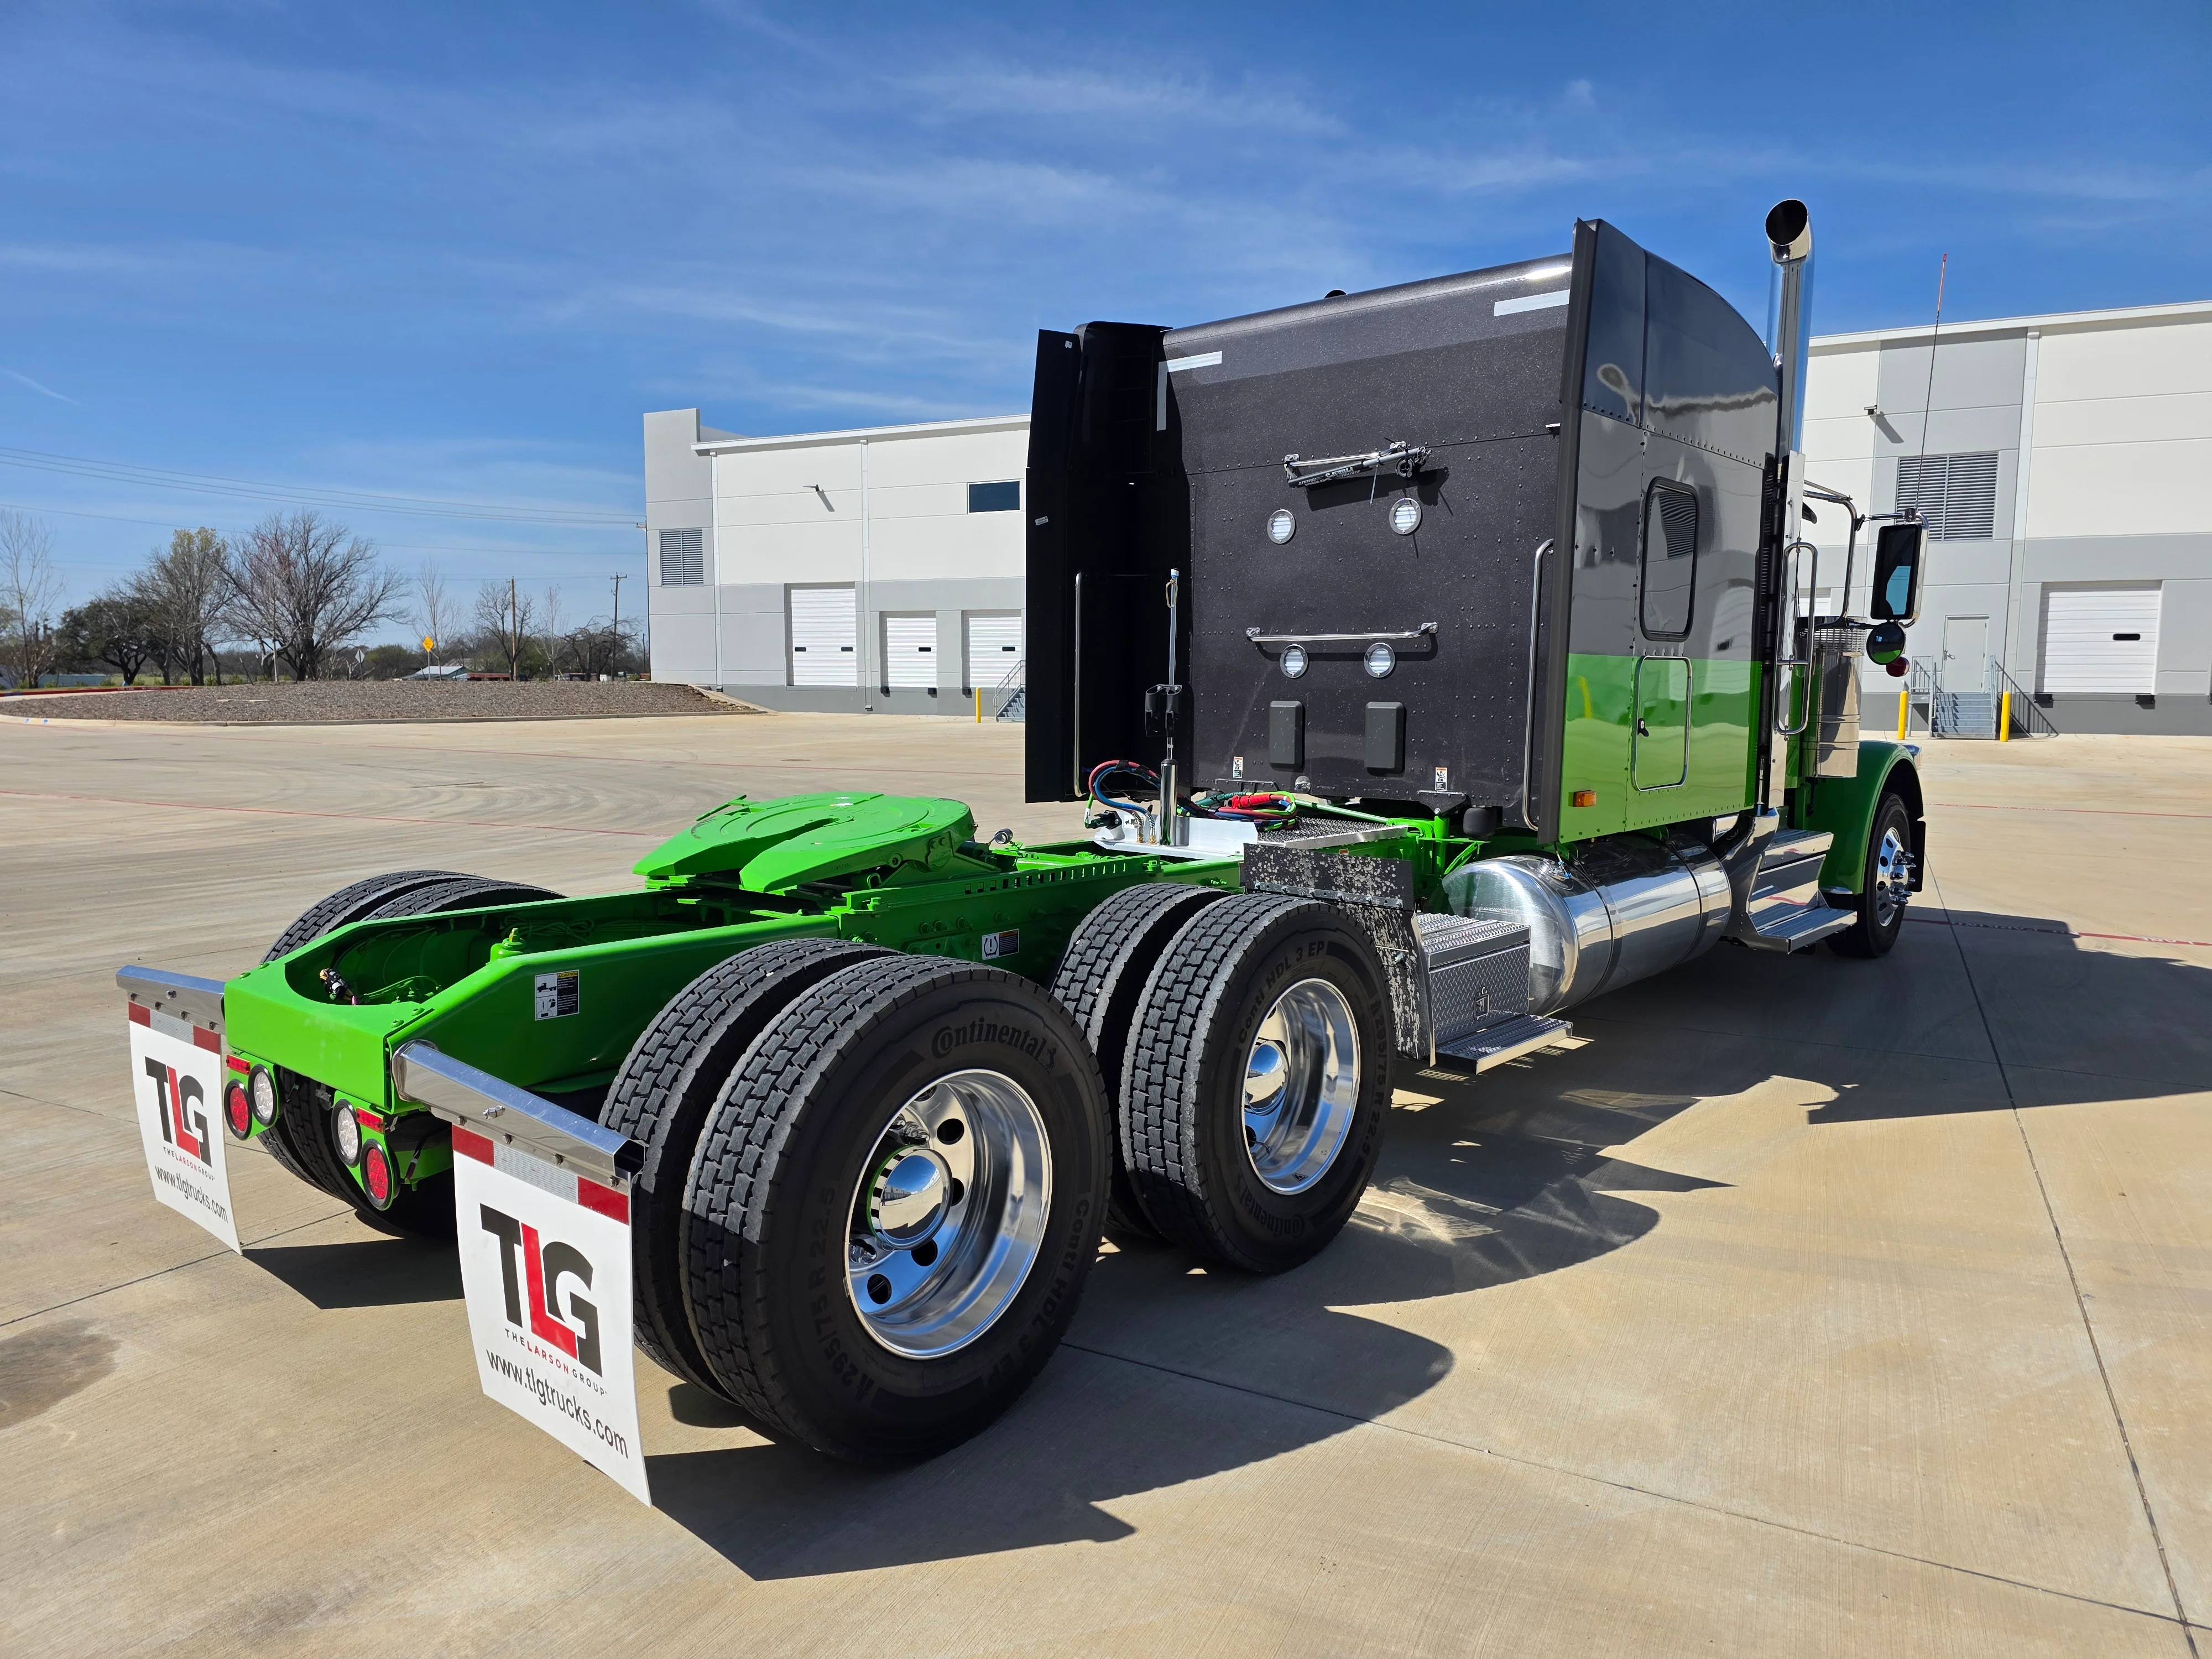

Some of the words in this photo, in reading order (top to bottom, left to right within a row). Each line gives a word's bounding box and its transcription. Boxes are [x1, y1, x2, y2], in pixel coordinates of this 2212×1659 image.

[1239, 987, 1266, 1043] Conti
[1266, 956, 1292, 990] HDL
[1296, 947, 1303, 962] 3
[1307, 941, 1324, 957] EP
[931, 1016, 1048, 1061] Continental
[1375, 1015, 1387, 1086] 295/75
[145, 1056, 212, 1168] TLG
[1373, 1091, 1384, 1105] R
[1360, 1109, 1380, 1156] 22.5
[154, 1164, 228, 1223] www.tlgtrucks.com
[1239, 1186, 1306, 1239] Continental
[809, 1187, 836, 1258] 22.5
[1062, 1199, 1089, 1271] Conti
[479, 1203, 603, 1378] TLG
[808, 1265, 826, 1291] R
[1031, 1278, 1067, 1329] HDL
[810, 1295, 859, 1386] 295/75
[1018, 1334, 1032, 1354] 3
[572, 1368, 604, 1396] GROUP
[988, 1353, 1015, 1387] EP
[486, 1348, 629, 1460] www.tlgtrucks.com
